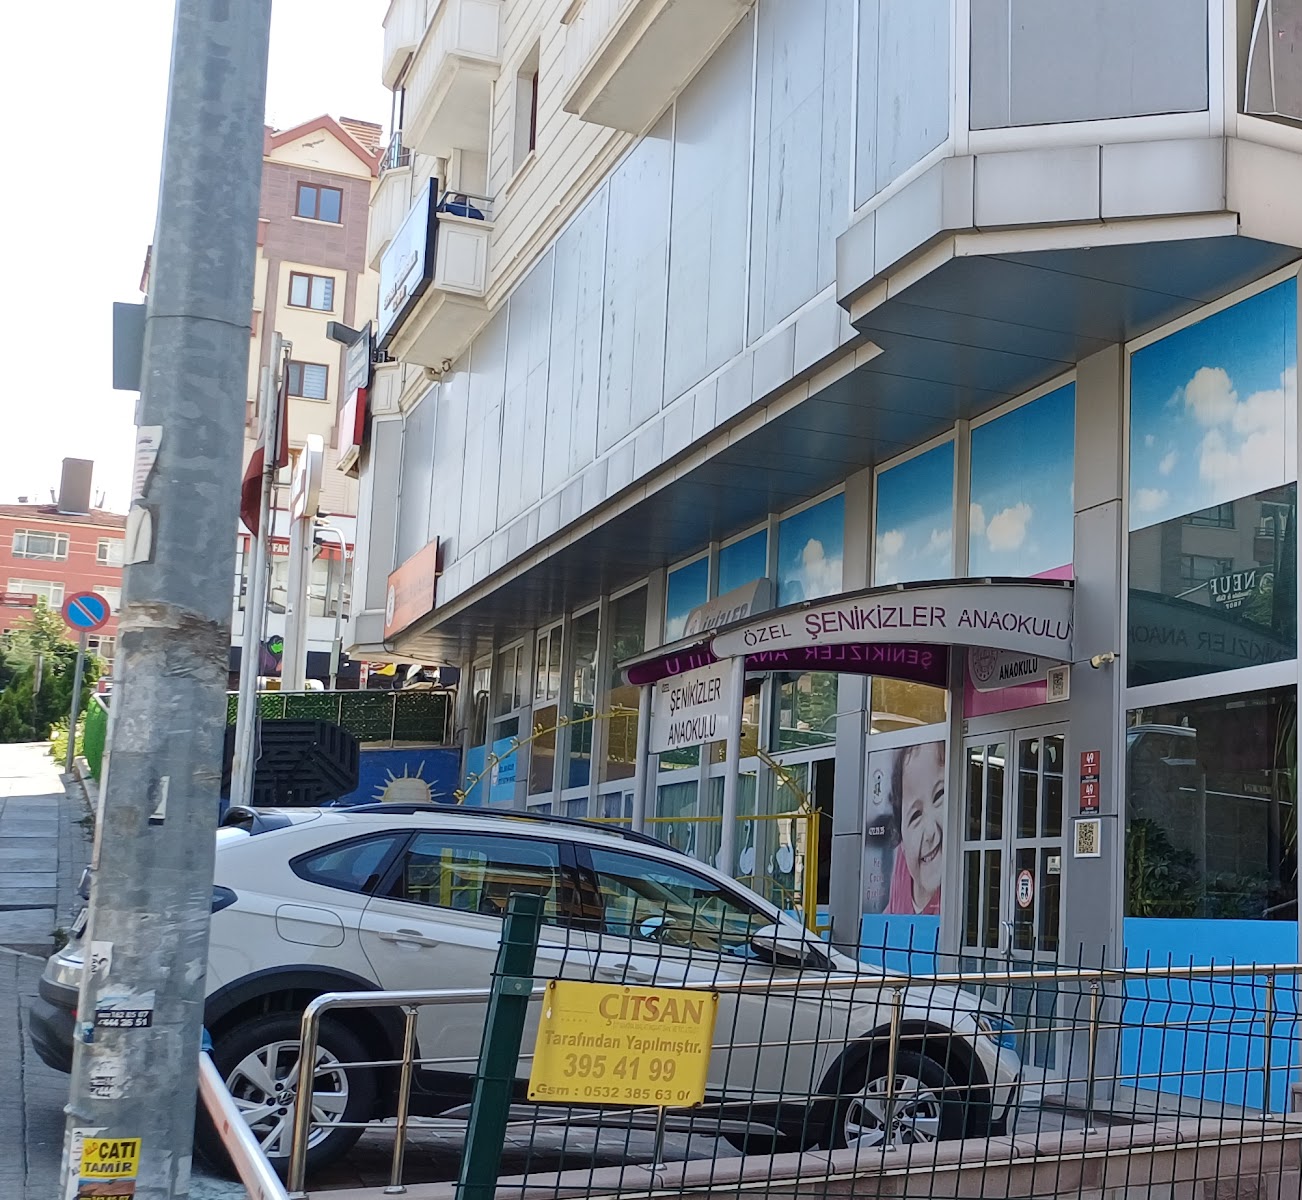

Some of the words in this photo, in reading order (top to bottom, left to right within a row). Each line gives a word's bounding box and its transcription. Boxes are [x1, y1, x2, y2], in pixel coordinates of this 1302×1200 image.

[743, 623, 792, 647] ÖZEL
[804, 604, 946, 640] ŞENİKİZLER
[957, 609, 1071, 641] ANAOKULU
[999, 657, 1038, 681] ANAOKULU
[669, 677, 722, 717] ŞENİKİZLER
[667, 714, 717, 746] ANAOKULU
[598, 987, 705, 1027] ÇİTSAN
[545, 1029, 621, 1049] Tarafından
[626, 1035, 702, 1056] Yapılmıştır.
[563, 1053, 607, 1079] 395
[612, 1055, 640, 1080] 41
[648, 1058, 677, 1082] 99
[536, 1083, 570, 1096] Gsm
[583, 1086, 620, 1098] 0532
[624, 1087, 651, 1099] 385
[654, 1089, 672, 1100] 63
[98, 1141, 137, 1162] ÇATI
[84, 1161, 133, 1173] TAMİR
